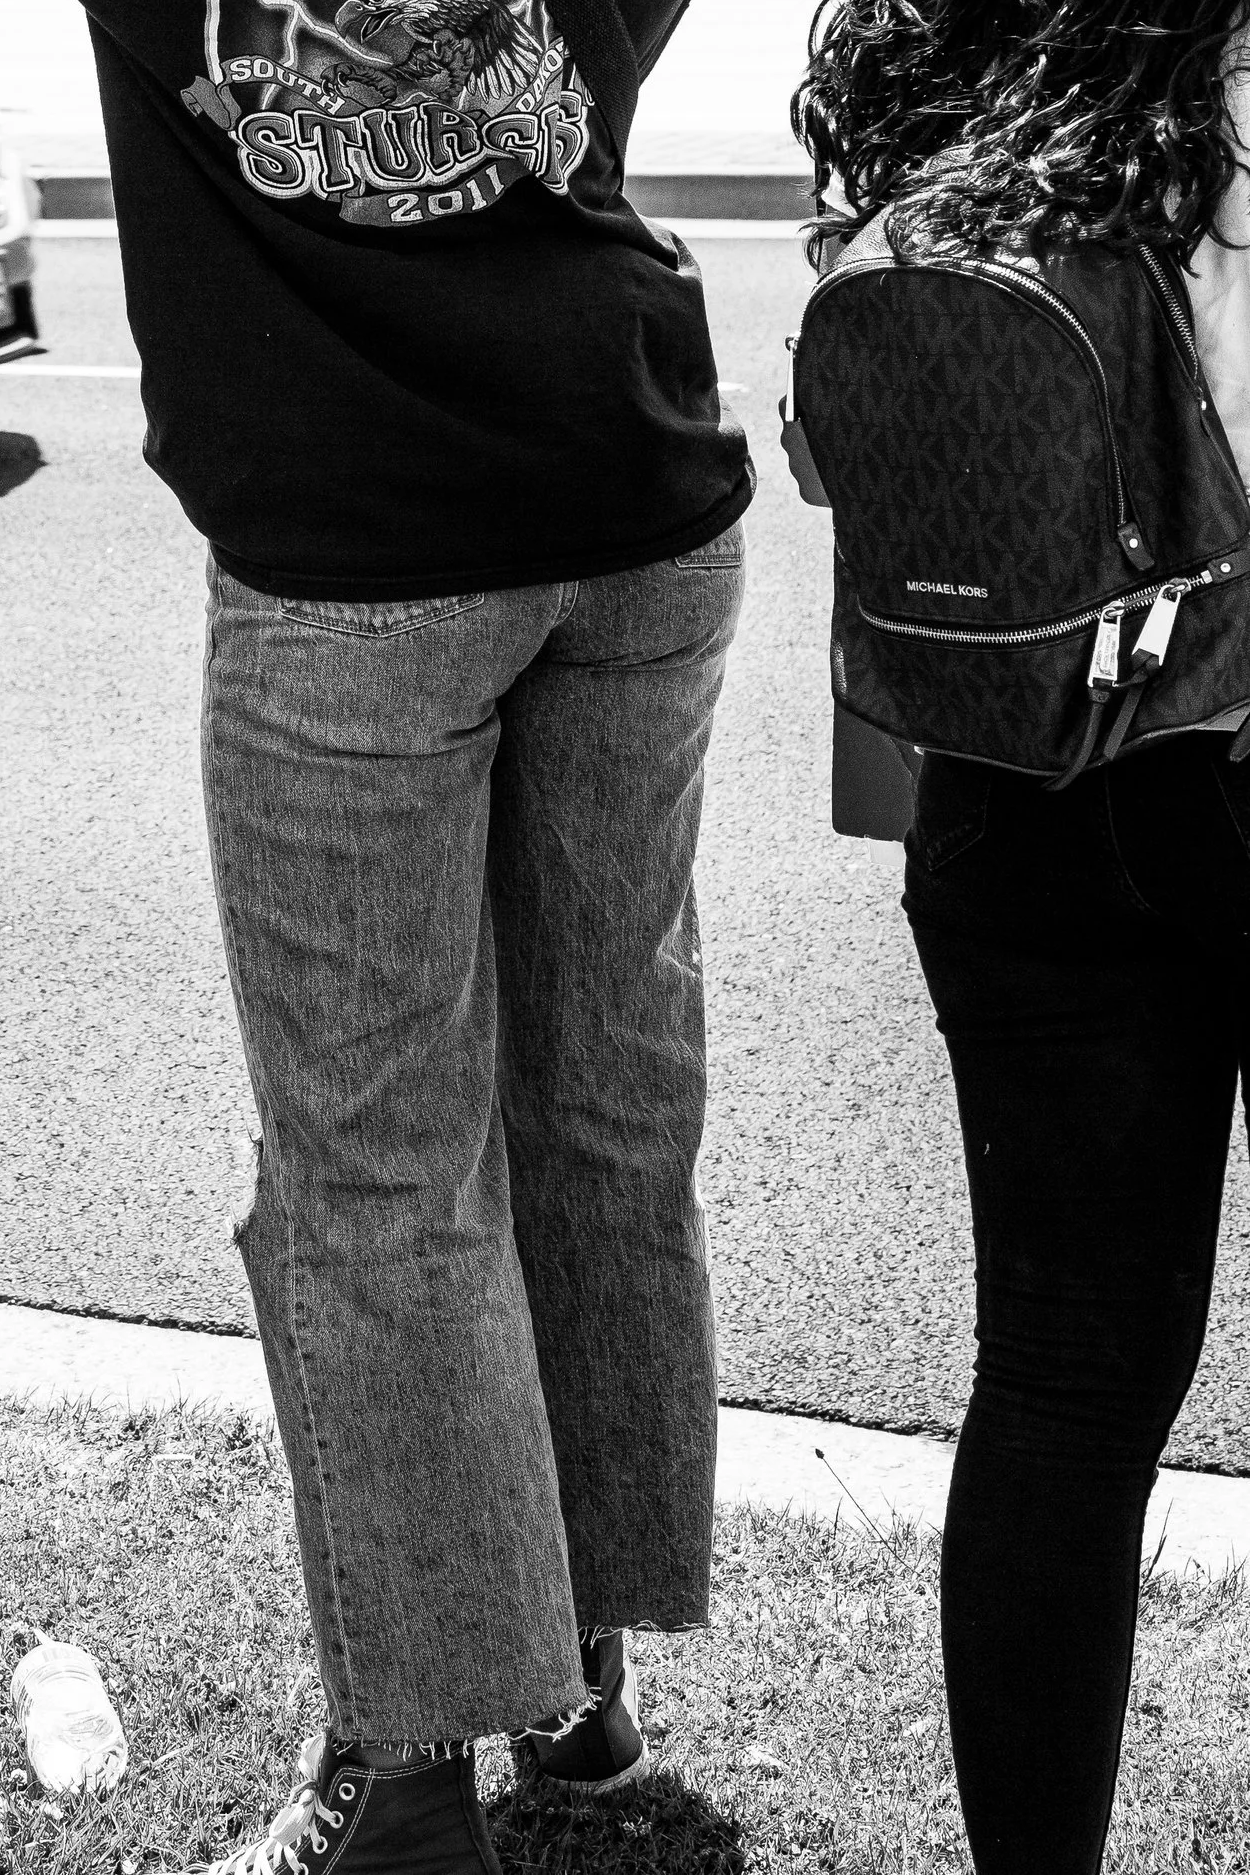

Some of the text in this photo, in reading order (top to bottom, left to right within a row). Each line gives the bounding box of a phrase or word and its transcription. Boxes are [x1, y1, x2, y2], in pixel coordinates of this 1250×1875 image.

[229, 58, 346, 116] SOUTH
[387, 164, 505, 222] 2011
[906, 580, 989, 599] MICHAEL KORS
